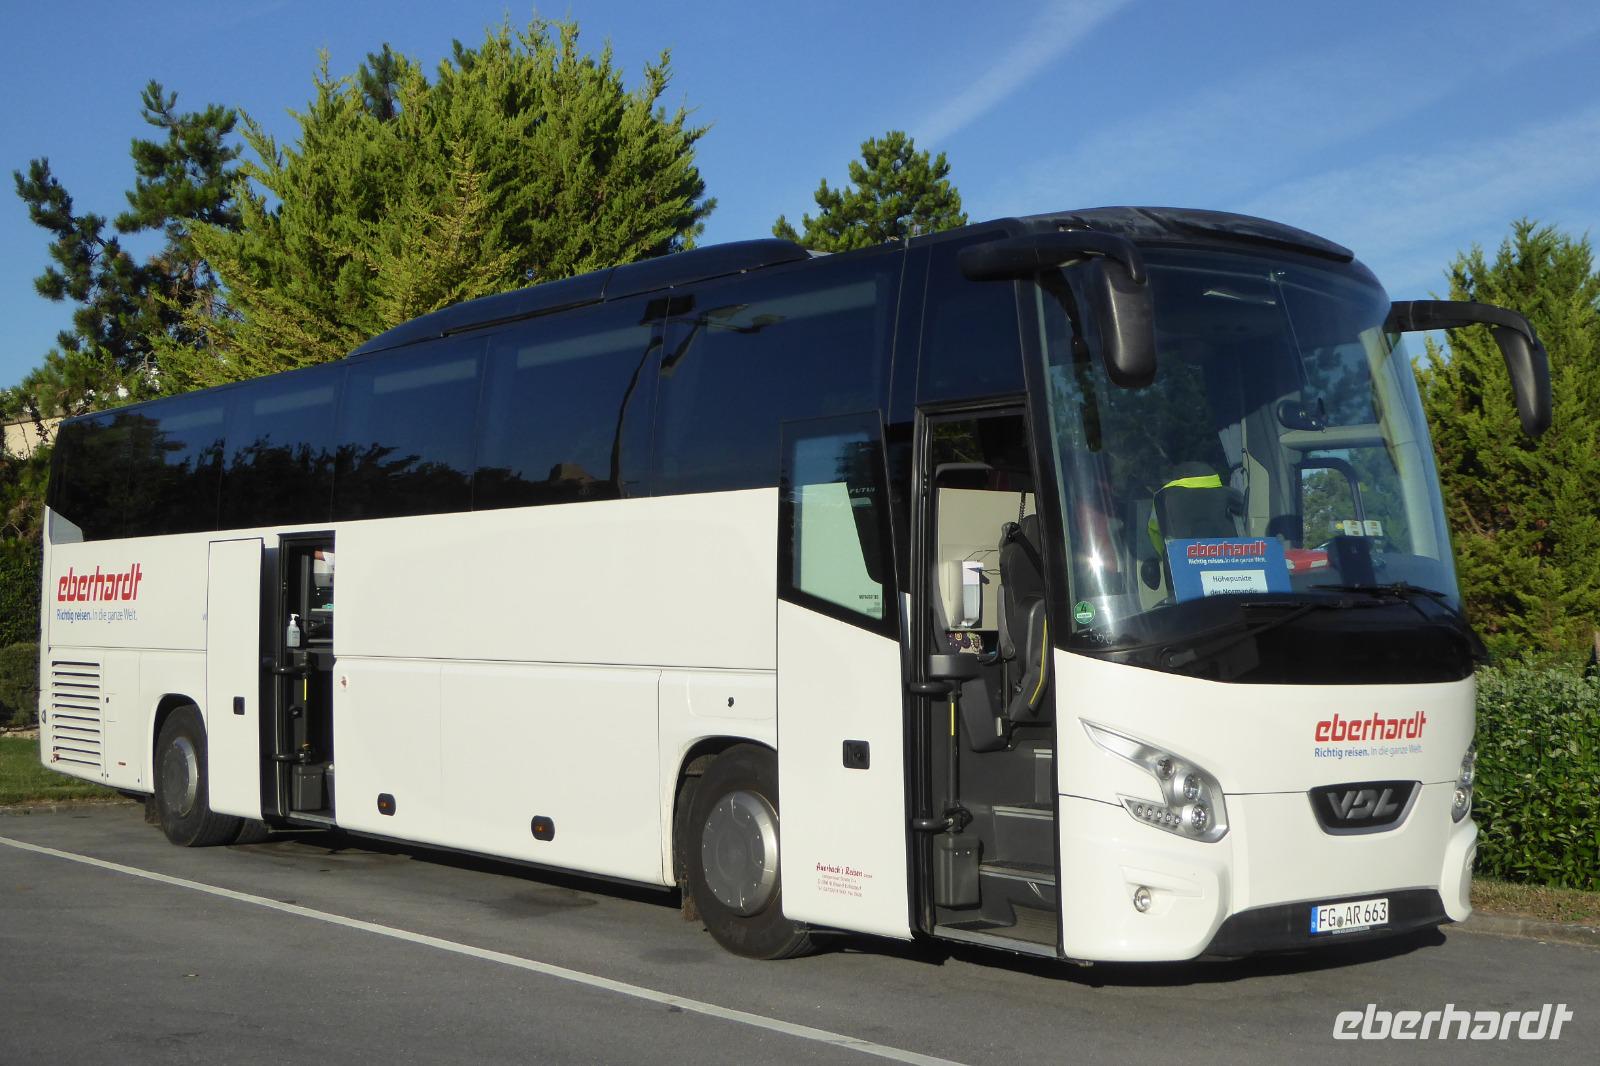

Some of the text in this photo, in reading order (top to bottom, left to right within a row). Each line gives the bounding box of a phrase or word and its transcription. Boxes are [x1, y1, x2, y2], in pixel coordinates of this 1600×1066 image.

[1187, 540, 1268, 558] eberhardt
[57, 563, 143, 602] eberhardt
[1212, 575, 1252, 583] Höhepunkte
[56, 609, 74, 623] Richtig
[74, 609, 92, 620] reisen.
[98, 608, 107, 620] die
[107, 611, 123, 623] ganze
[123, 608, 137, 620] Welt.
[1080, 604, 1086, 612] 4
[1314, 710, 1427, 742] eberhardt
[1314, 747, 1343, 759] Richtig
[1344, 746, 1370, 757] reisen.
[1378, 746, 1388, 755] die
[1389, 746, 1408, 757] ganze
[1327, 788, 1399, 820] VDL
[1319, 908, 1336, 929] FG
[1345, 905, 1361, 925] AR
[1364, 902, 1387, 922] 663
